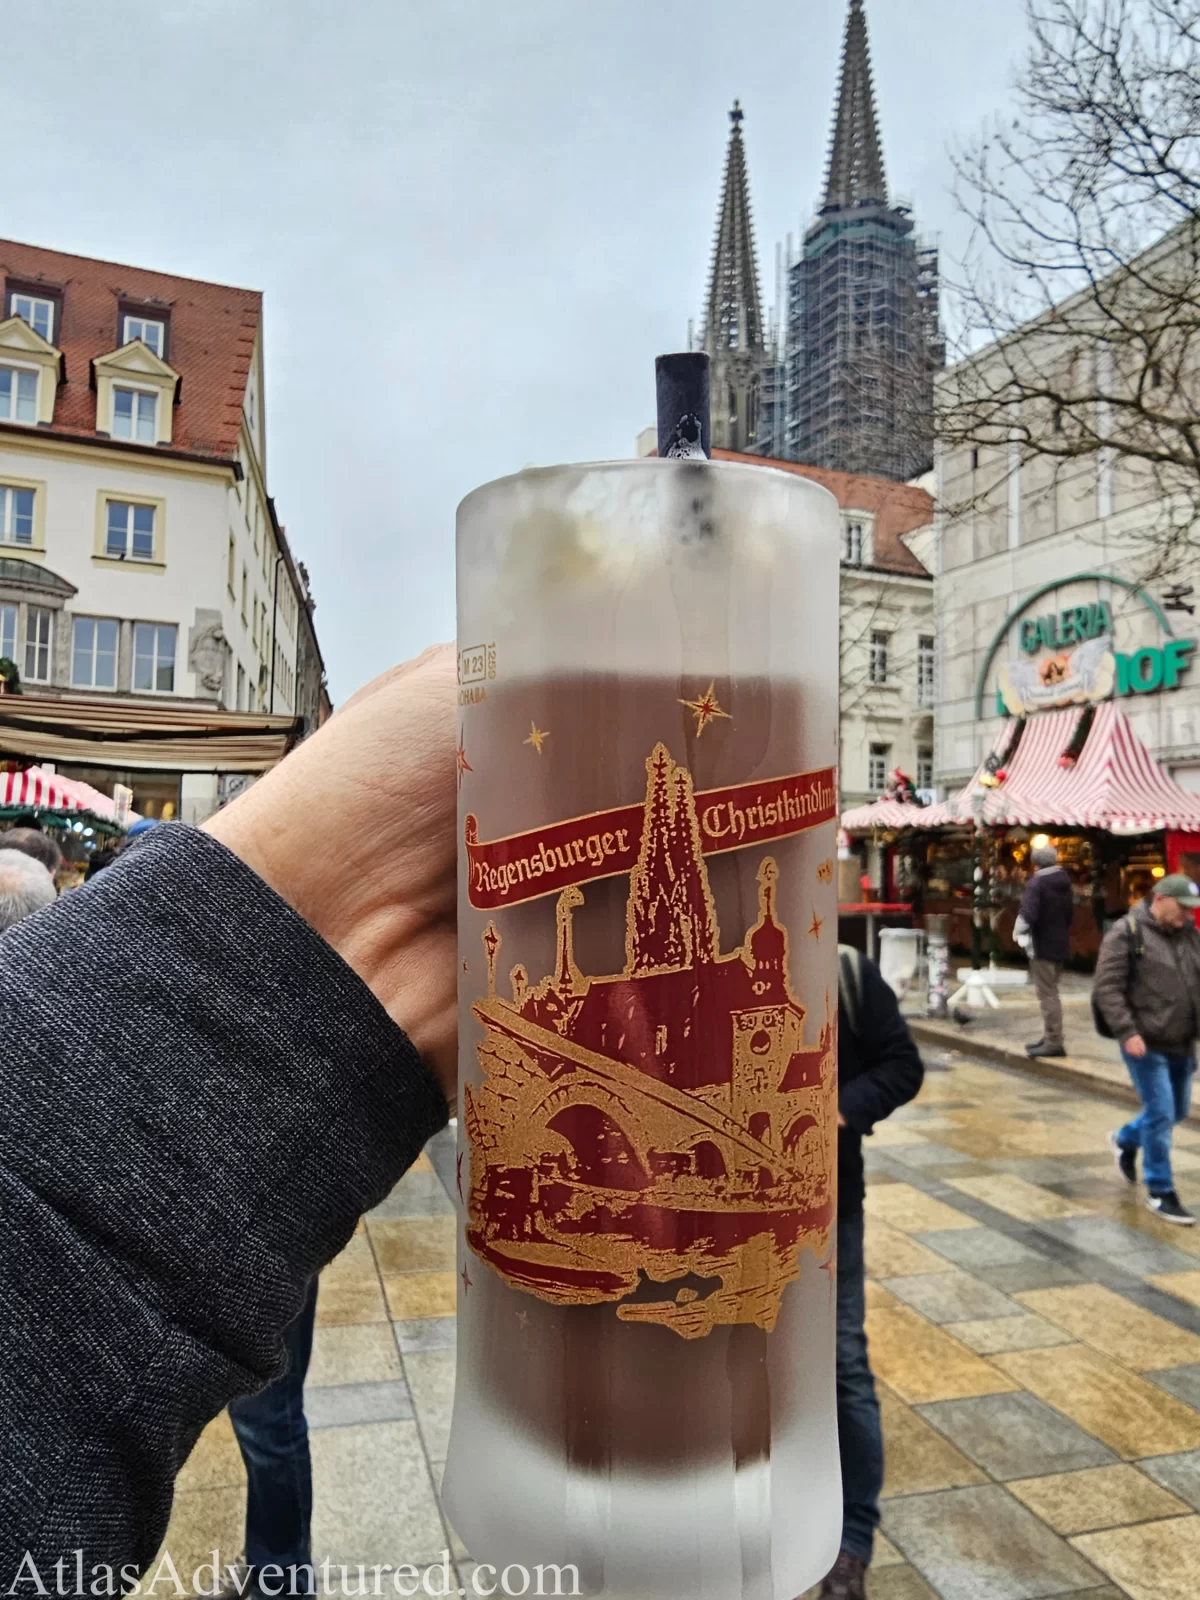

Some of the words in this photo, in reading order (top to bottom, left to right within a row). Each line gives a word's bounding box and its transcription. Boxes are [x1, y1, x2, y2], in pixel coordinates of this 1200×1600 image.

[1019, 600, 1111, 651] GALERIA
[471, 655, 484, 674] 23
[475, 827, 631, 896] Regensburger
